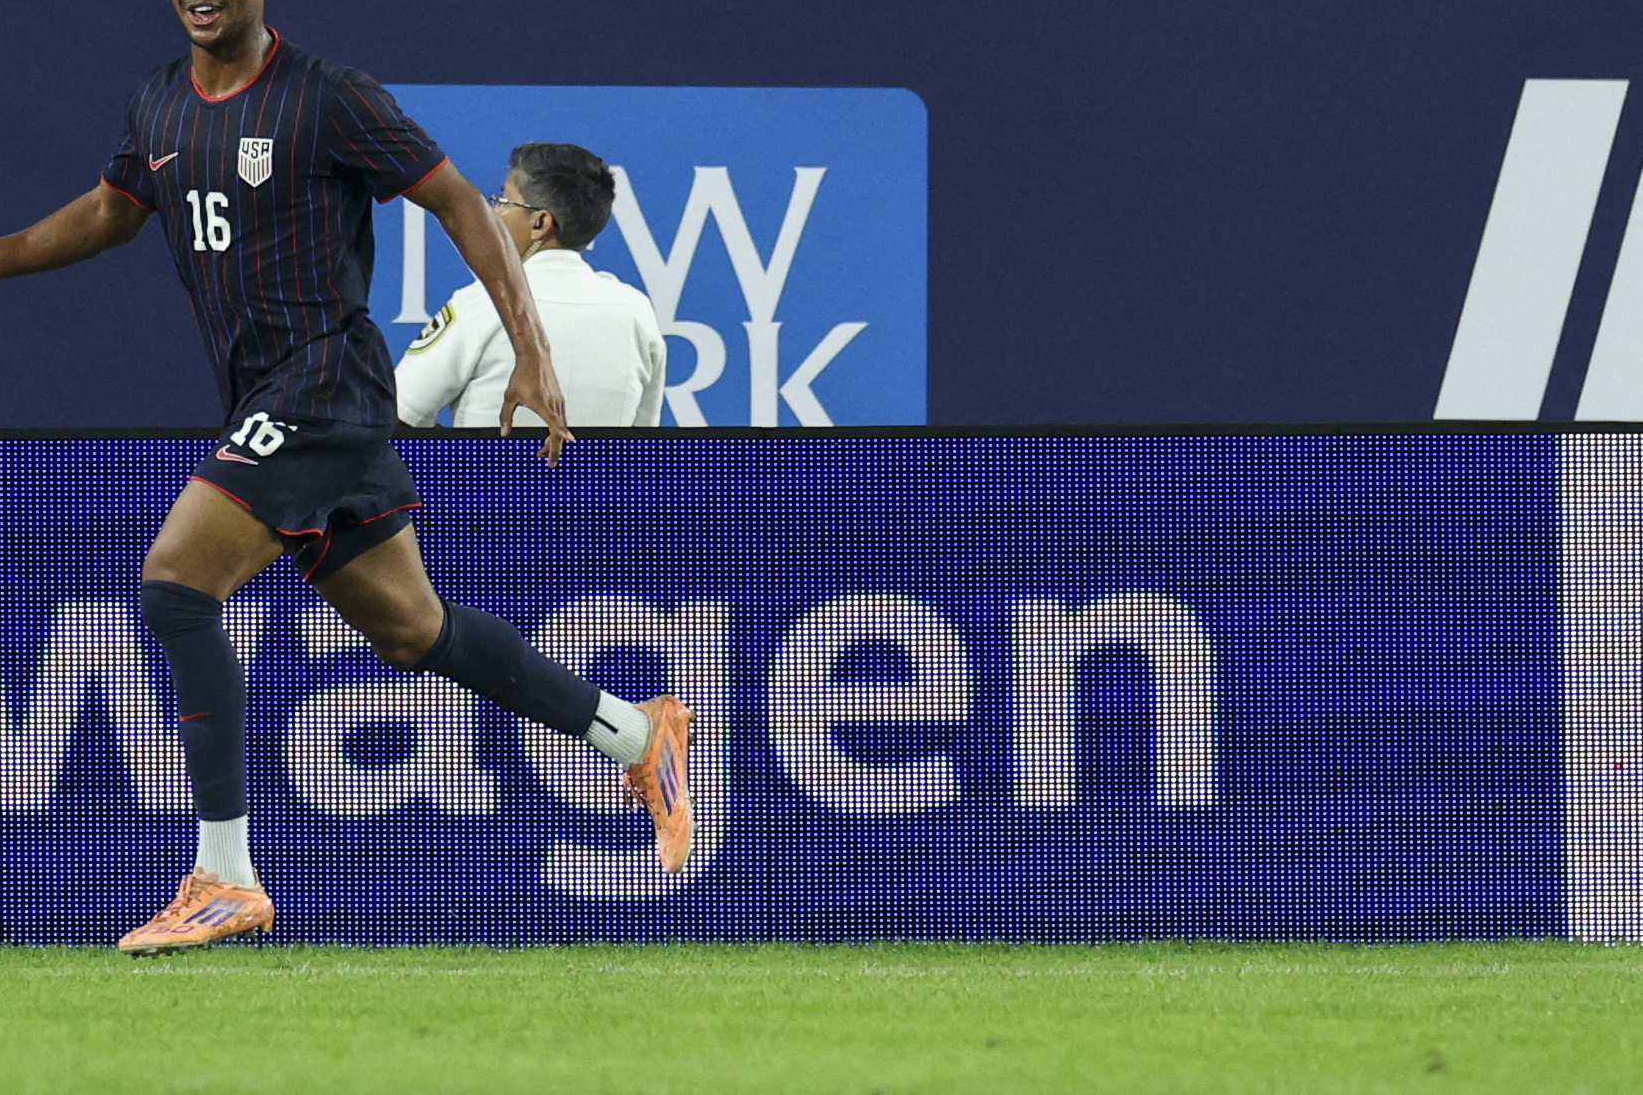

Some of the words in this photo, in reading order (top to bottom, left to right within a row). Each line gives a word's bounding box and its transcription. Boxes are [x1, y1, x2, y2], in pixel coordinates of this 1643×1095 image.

[242, 140, 270, 159] USA
[186, 189, 231, 252] 16
[663, 321, 869, 427] RK
[230, 411, 298, 457] 16
